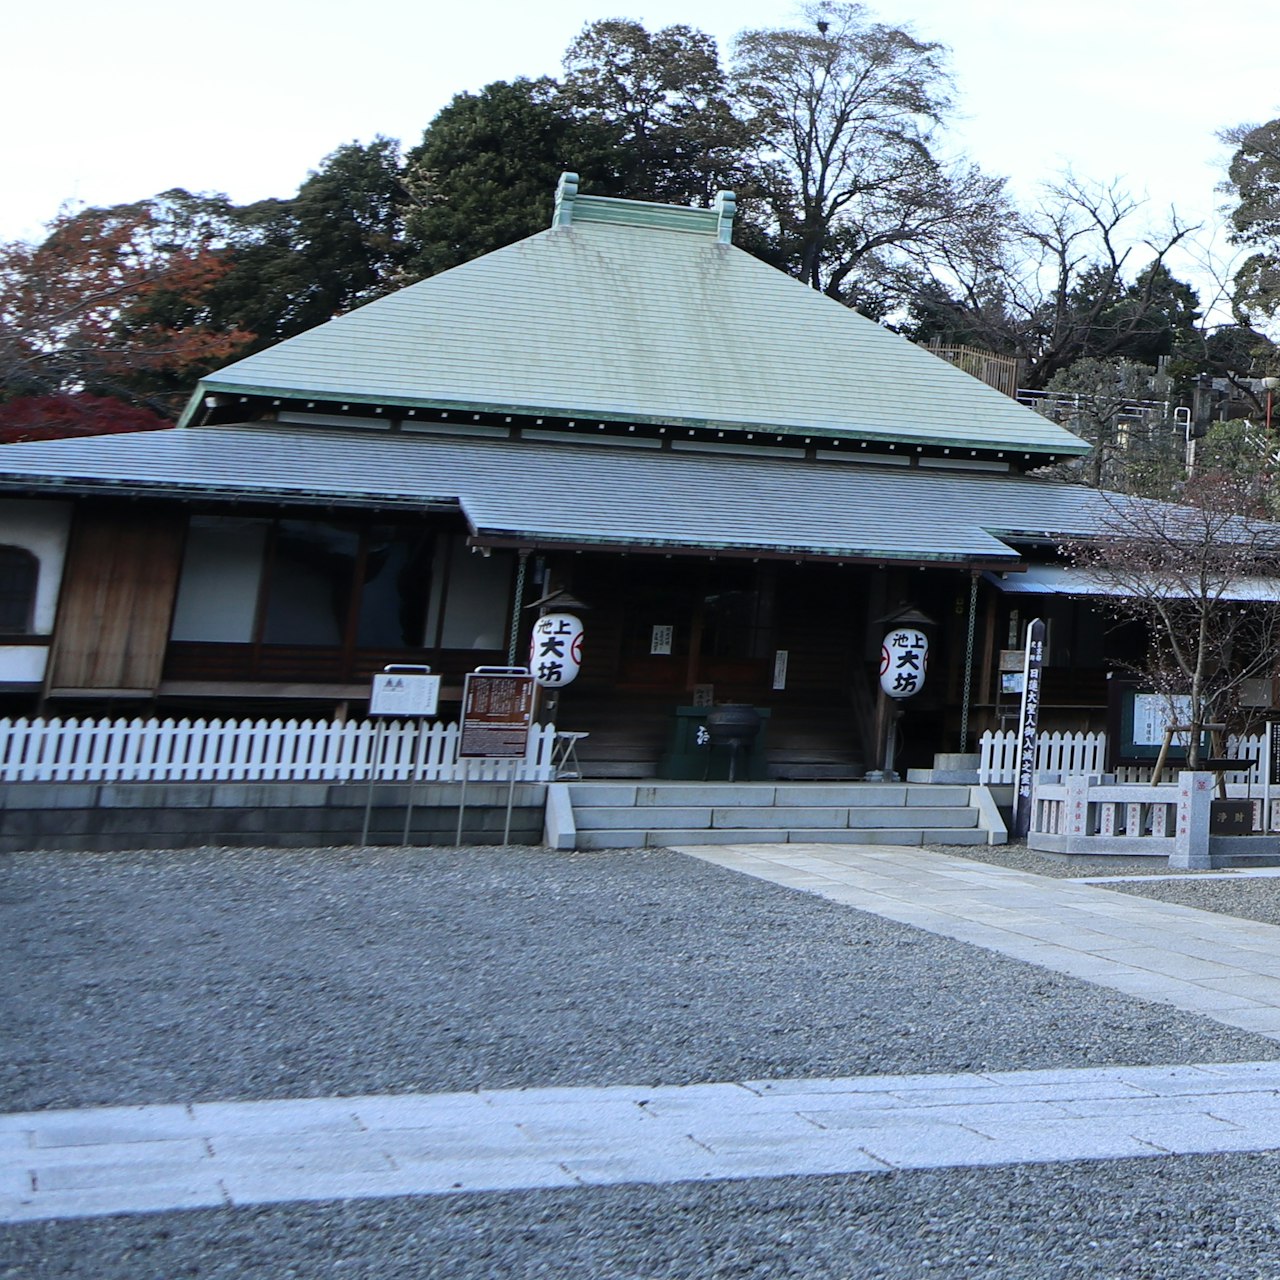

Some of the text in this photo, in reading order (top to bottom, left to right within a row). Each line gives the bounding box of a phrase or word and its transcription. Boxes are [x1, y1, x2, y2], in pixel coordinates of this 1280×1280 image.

[537, 619, 572, 635] 池上
[892, 633, 925, 649] 池上
[538, 636, 565, 682] 大坊
[892, 650, 919, 693] 大坊
